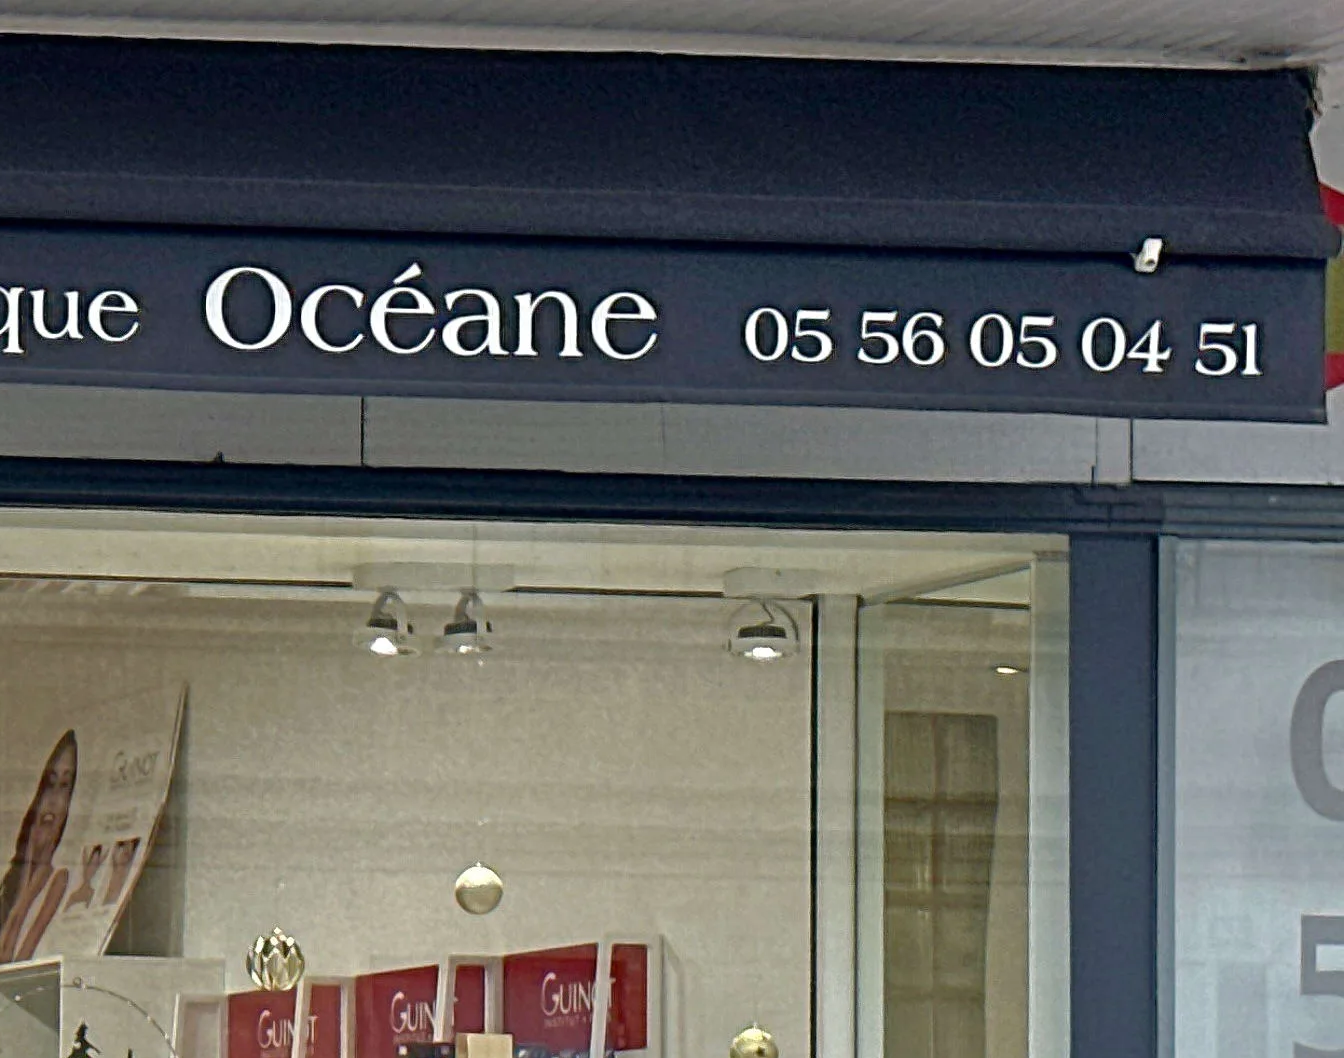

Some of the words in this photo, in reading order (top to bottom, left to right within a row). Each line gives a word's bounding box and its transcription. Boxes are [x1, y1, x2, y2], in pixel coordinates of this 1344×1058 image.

[203, 262, 659, 360] Océane
[743, 306, 834, 363] 05
[856, 311, 945, 367] 56
[968, 314, 1058, 369] 05
[1081, 318, 1172, 374] 04
[1194, 323, 1263, 377] 51
